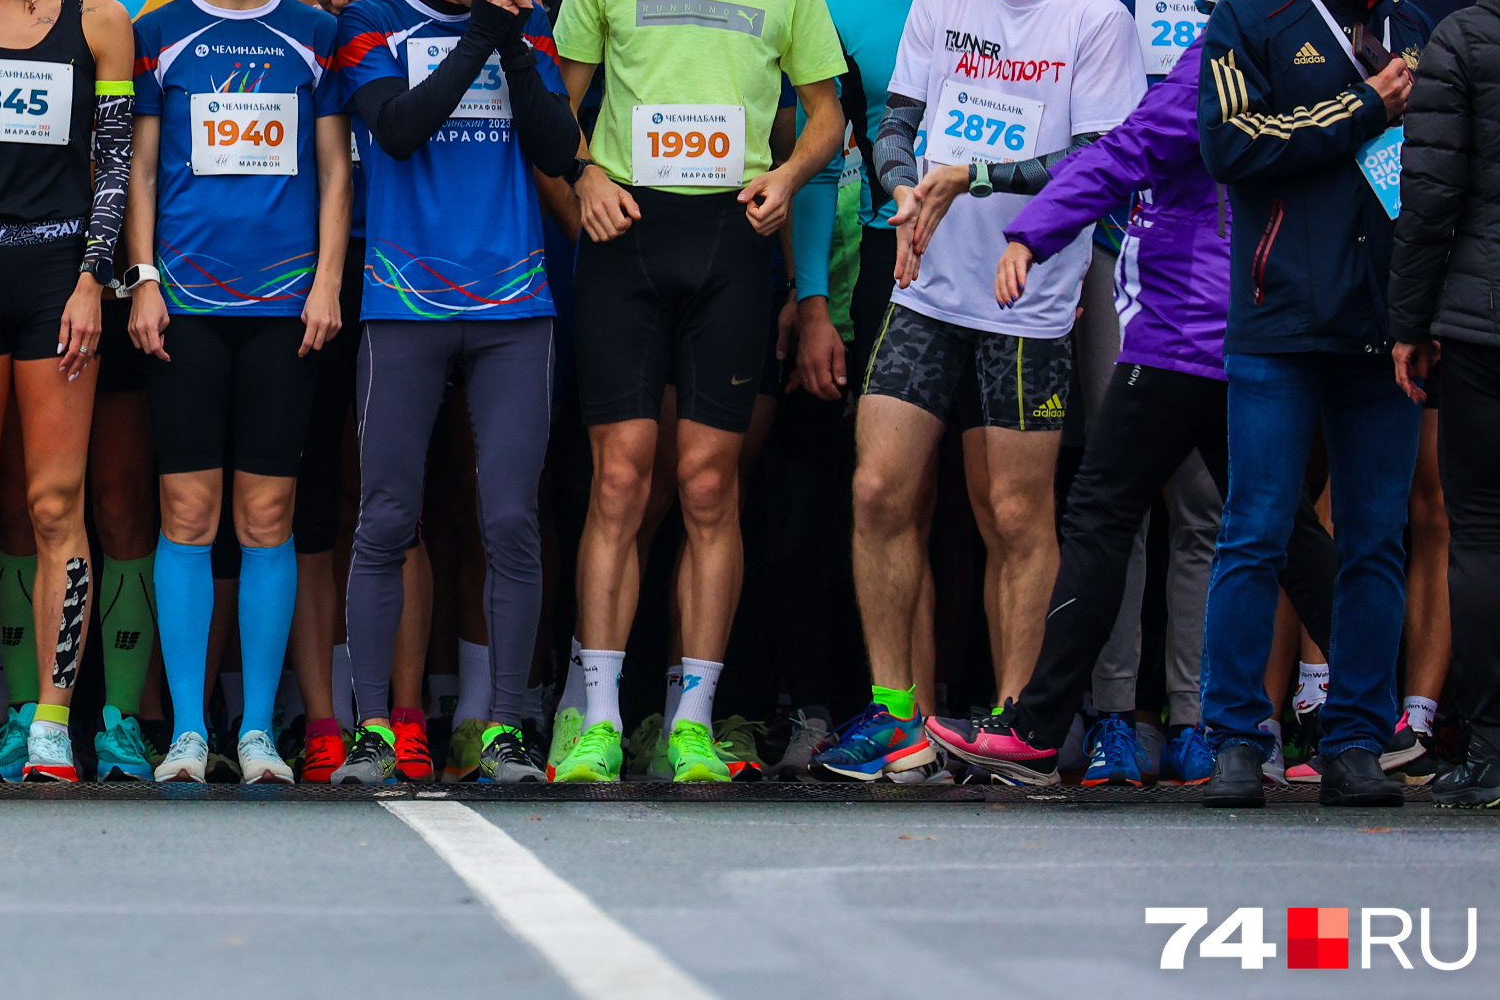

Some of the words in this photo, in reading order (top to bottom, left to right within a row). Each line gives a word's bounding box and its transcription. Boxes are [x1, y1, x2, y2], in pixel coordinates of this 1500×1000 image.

[642, 4, 730, 16] RUNNING
[212, 45, 285, 57] ЧЕЛИНДБАНК
[1293, 55, 1326, 65] adidas
[954, 51, 1066, 83] АНТИСПОРТ
[221, 103, 282, 112] ЧЕЛИНДБАНК
[969, 95, 1024, 116] ЧЕЛИНДБАНК
[488, 118, 511, 129] 2023
[665, 114, 727, 123] ЧЕЛИНДБАНК
[4, 128, 50, 137] МАРАФОН
[203, 119, 285, 147] 1940
[429, 130, 511, 142] АРАФОН
[944, 109, 1027, 151] 2876
[647, 131, 730, 158] 1990
[239, 160, 280, 168] МАРАФОН
[33, 220, 80, 239] RAY
[1033, 408, 1065, 418] adidas
[114, 642, 136, 650] cep
